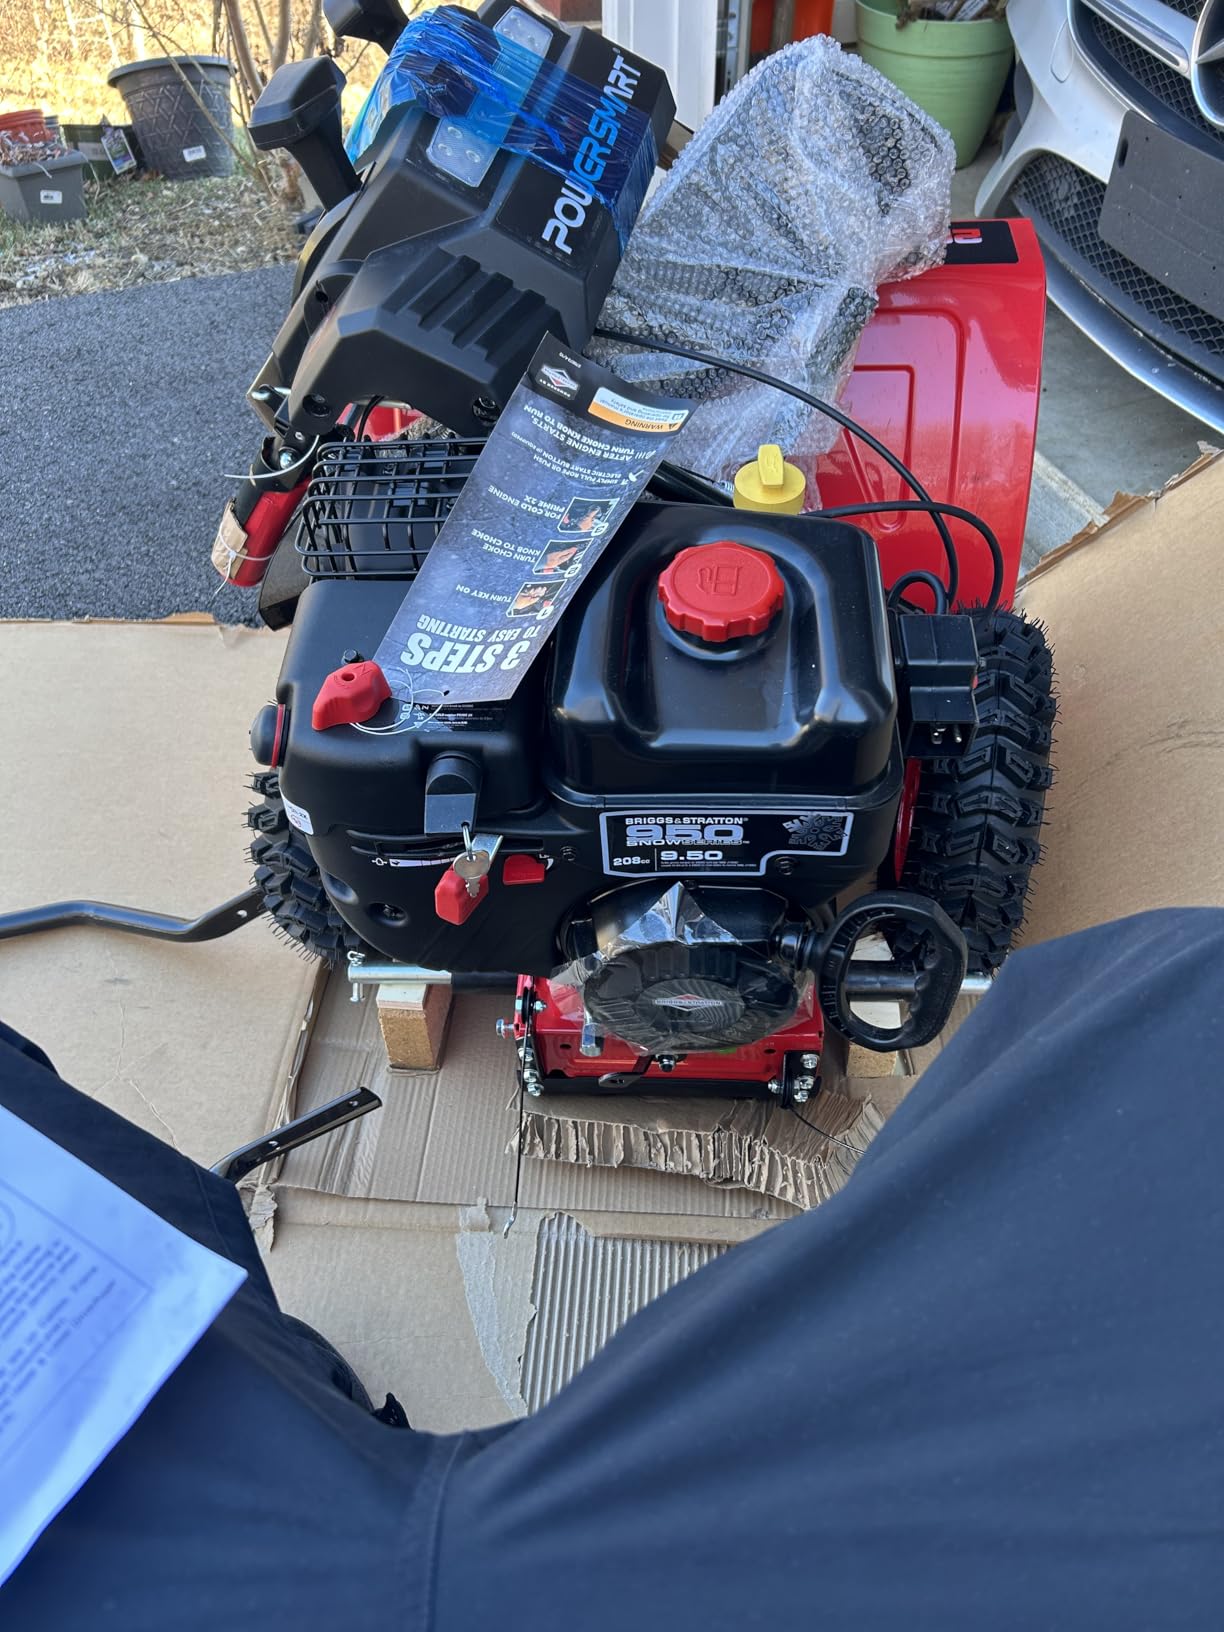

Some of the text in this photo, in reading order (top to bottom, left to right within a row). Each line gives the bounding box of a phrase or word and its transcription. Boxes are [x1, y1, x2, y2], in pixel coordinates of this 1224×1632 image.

[541, 54, 642, 256] POWERSMART
[524, 404, 635, 455] TURN CHOKE KNOB TO RUN
[624, 418, 664, 430] WARNING
[566, 437, 602, 458] ENGINE
[542, 451, 570, 468] BUTTON
[602, 451, 633, 461] AFTER
[533, 454, 619, 485] SIMPLY PULL ROPE OR PUSH
[570, 464, 591, 474] START
[591, 470, 622, 479] ELECTRIC
[487, 484, 520, 507] ENGINE
[523, 494, 565, 512] PRIME 2X
[520, 502, 544, 515] COLD
[544, 511, 562, 520] FOR
[471, 528, 541, 556] KNOB TO CHOKE
[482, 543, 513, 558] CHOKE
[513, 553, 536, 563] TURN
[455, 584, 471, 594] ON
[471, 589, 490, 600] KEY
[489, 593, 512, 603] TURN
[416, 614, 542, 642] TO EASY STARTING
[400, 632, 531, 673] 3 STEPS
[626, 824, 744, 841] 950
[613, 850, 723, 866] 208cc 9.50
